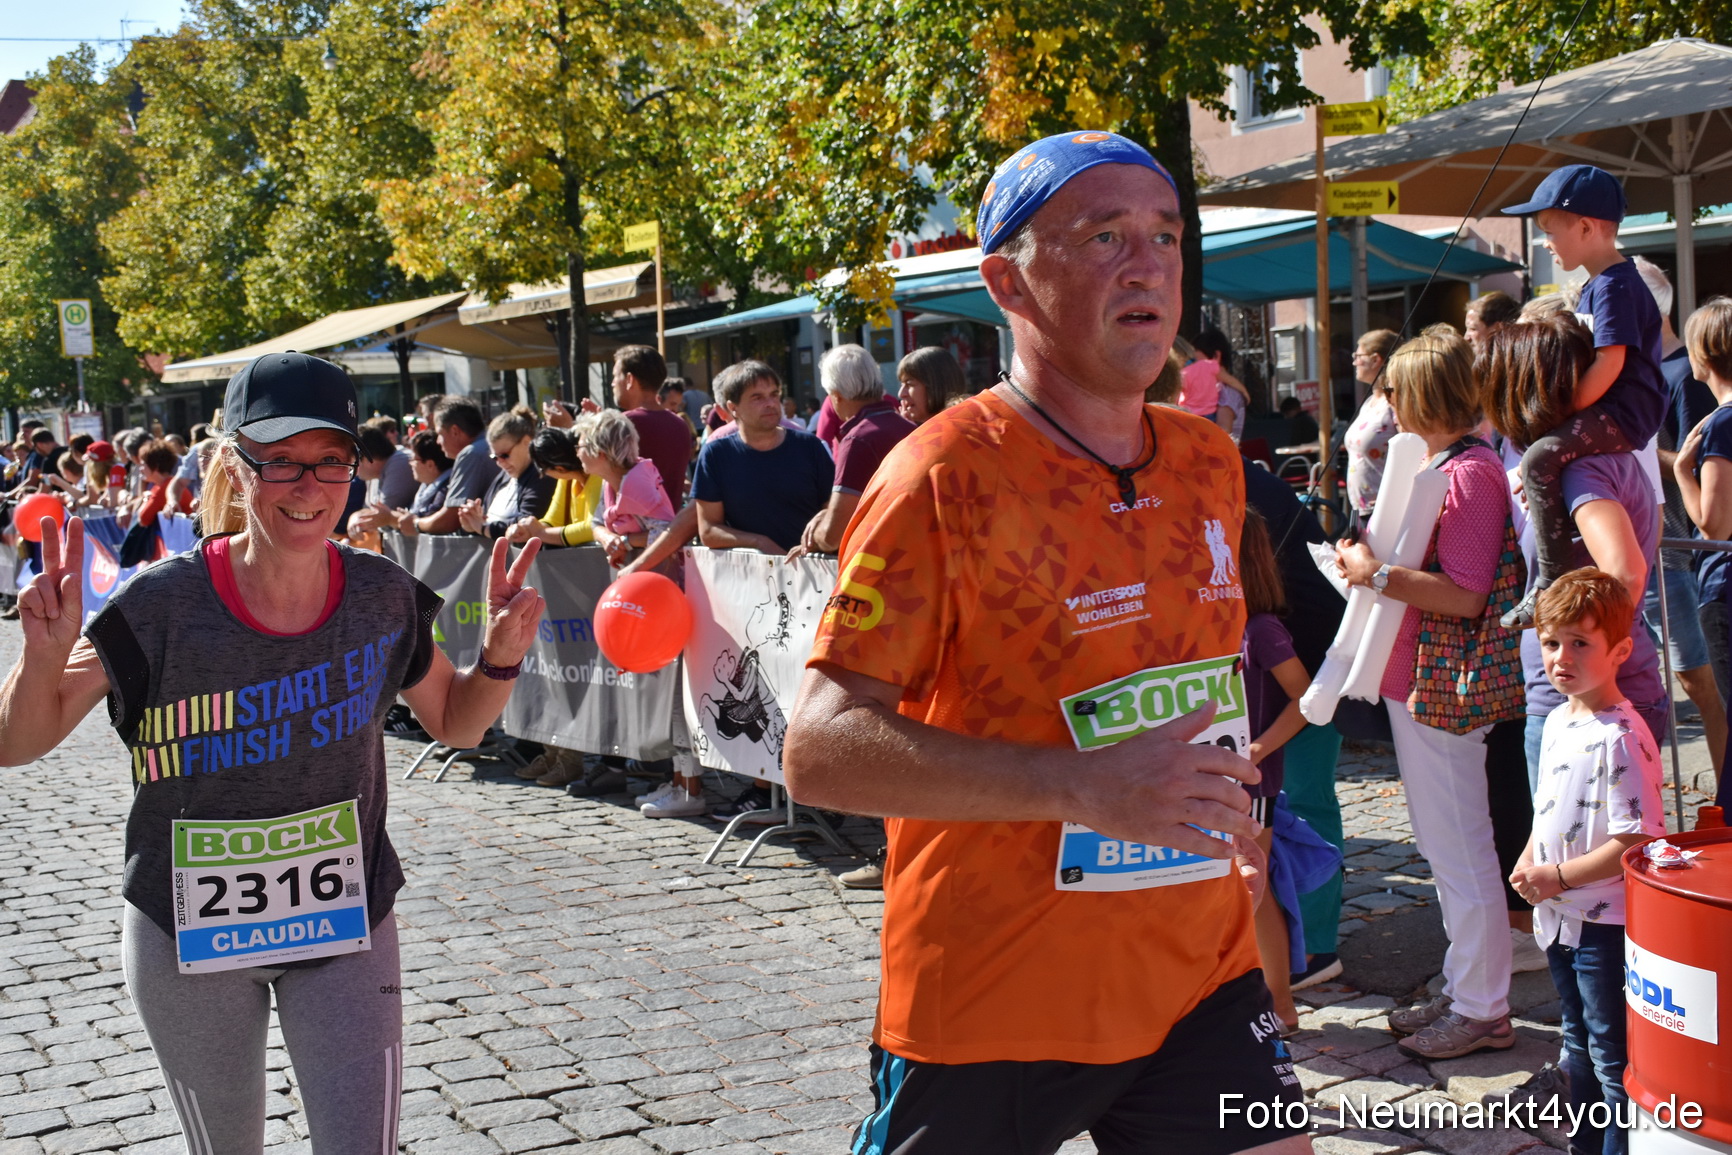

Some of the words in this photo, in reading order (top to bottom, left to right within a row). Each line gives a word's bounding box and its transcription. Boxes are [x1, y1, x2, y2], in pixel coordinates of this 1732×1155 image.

[1333, 188, 1383, 199] Kleiderbeutel-
[1343, 202, 1373, 212] ausgabe
[70, 309, 81, 320] H
[1077, 600, 1144, 624] WOHLLEBEN
[1082, 582, 1146, 608] INTERSPORT
[237, 662, 332, 727] START
[1096, 671, 1232, 730] BOCK
[183, 720, 291, 777] FINISH
[191, 812, 347, 858] BOCK
[197, 857, 344, 919] 2316
[211, 918, 336, 952] CLAUDIA
